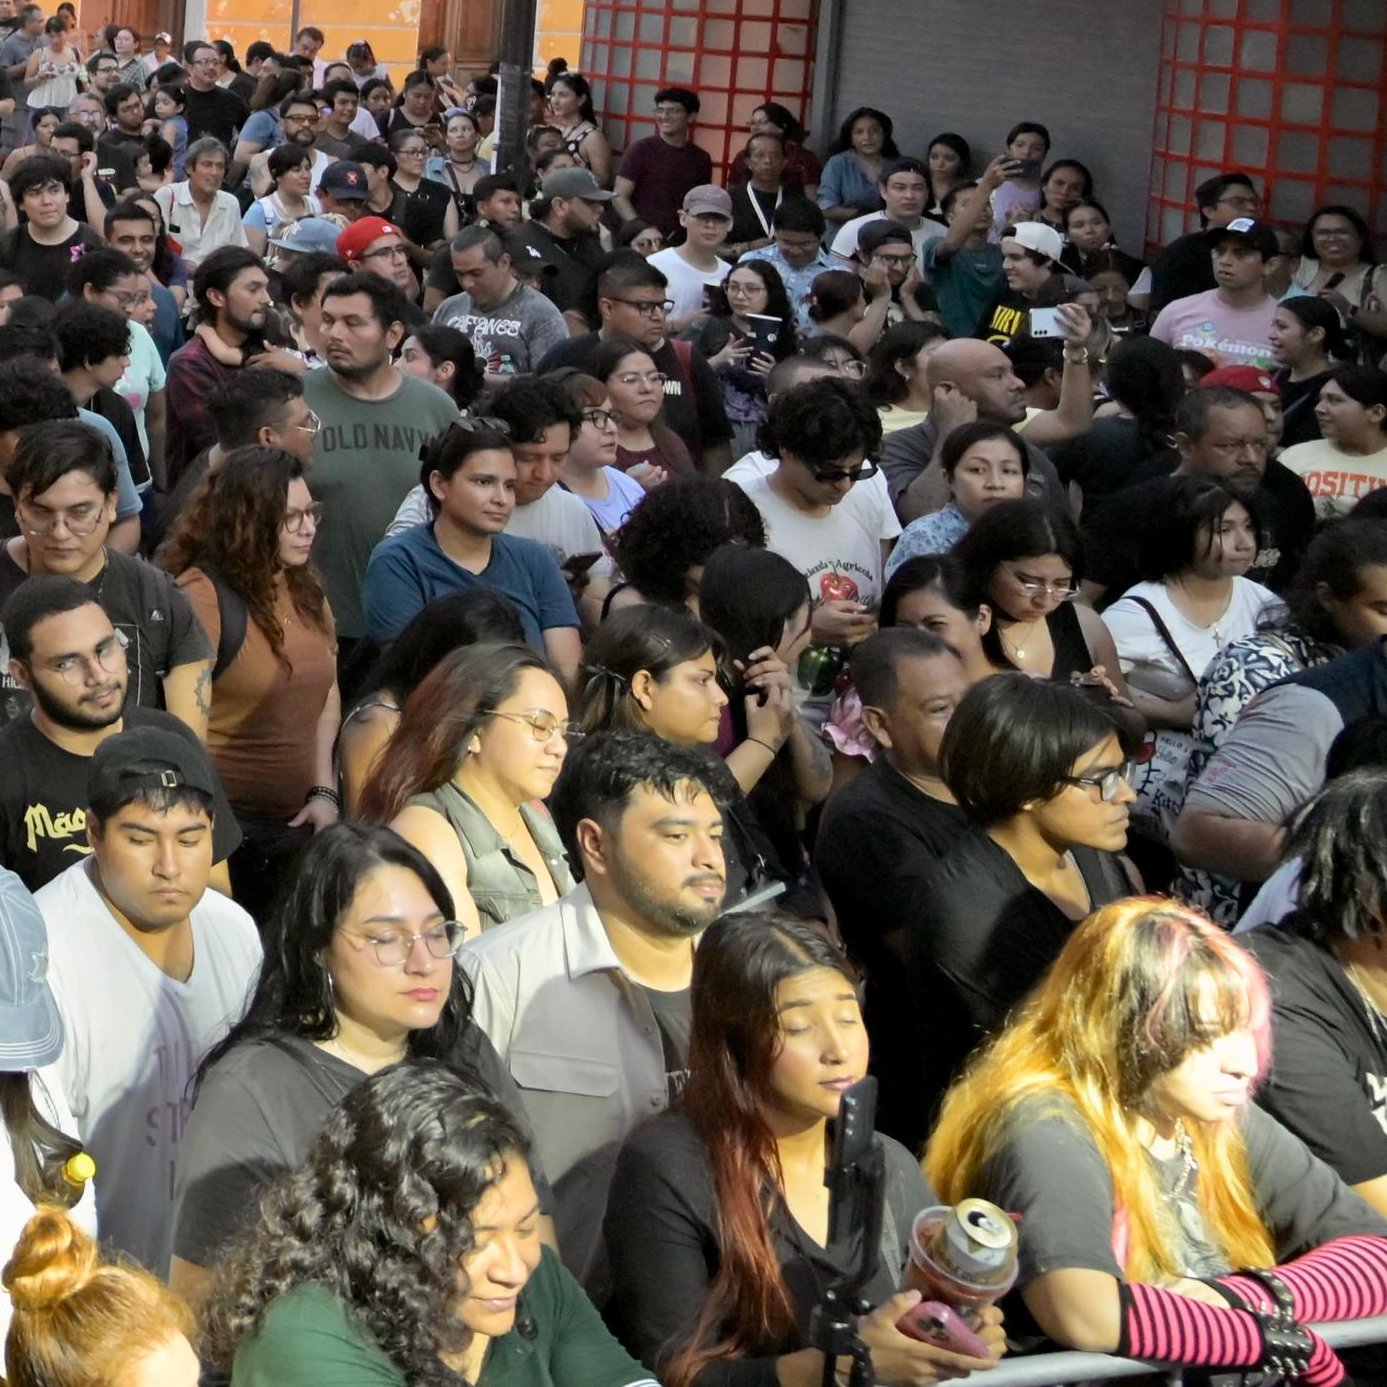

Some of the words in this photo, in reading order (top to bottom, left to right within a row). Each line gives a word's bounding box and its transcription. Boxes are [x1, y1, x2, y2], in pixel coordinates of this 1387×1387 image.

[991, 305, 1023, 335] NIRV
[1181, 334, 1273, 358] Pokémon
[323, 423, 368, 452] OLD
[374, 423, 429, 453] NAVY
